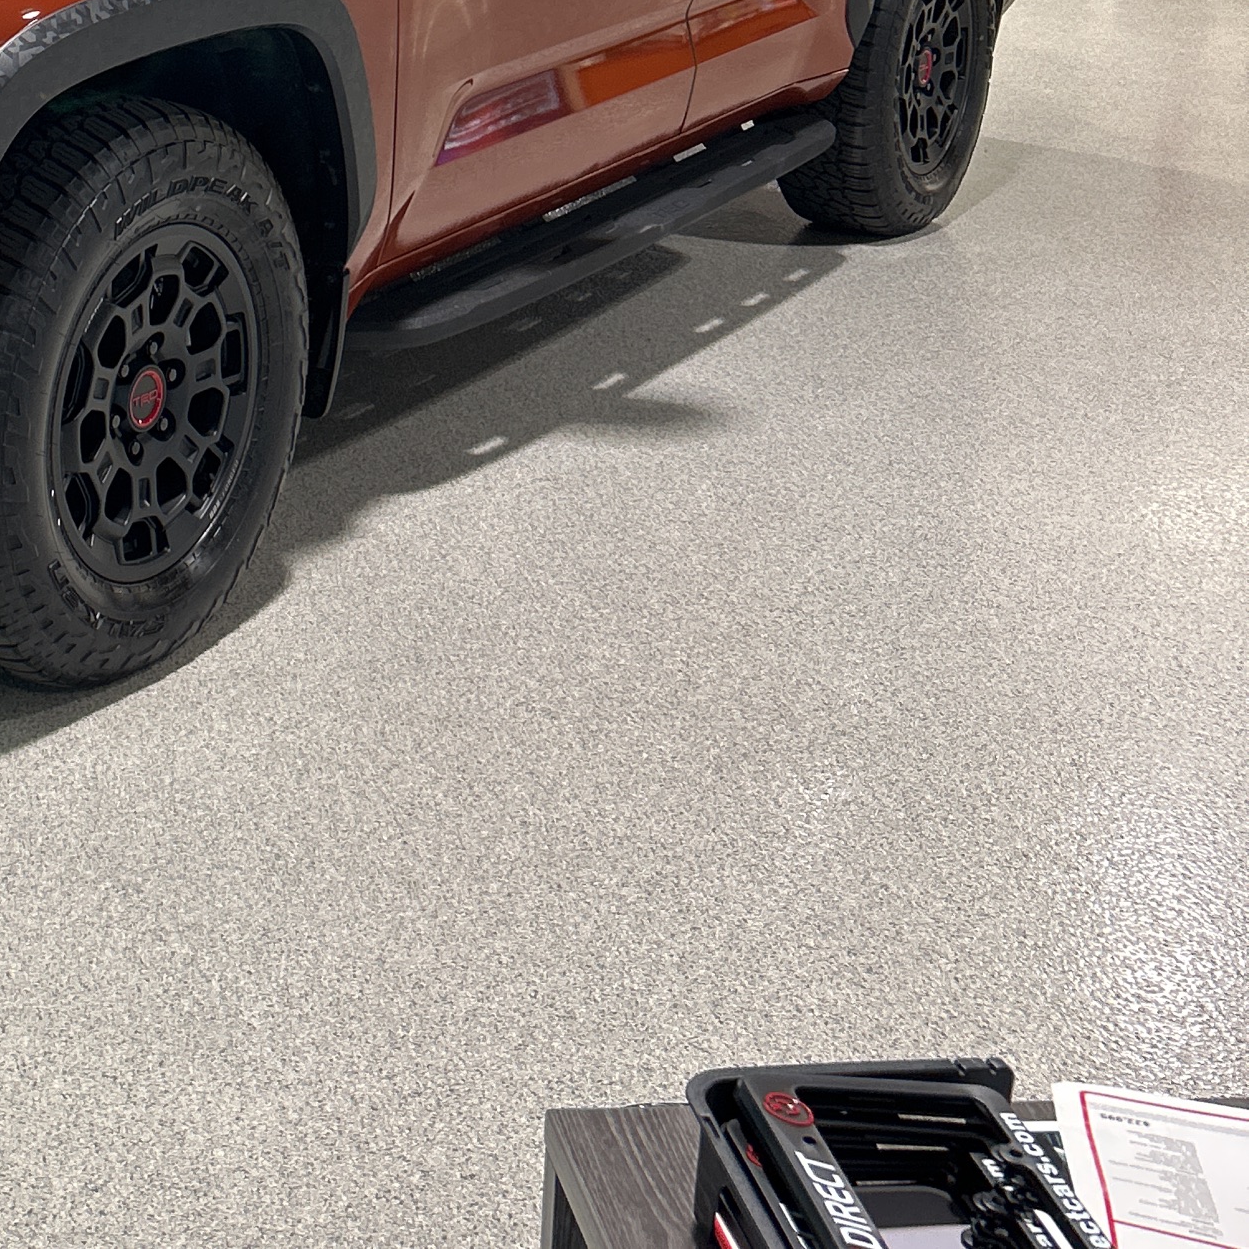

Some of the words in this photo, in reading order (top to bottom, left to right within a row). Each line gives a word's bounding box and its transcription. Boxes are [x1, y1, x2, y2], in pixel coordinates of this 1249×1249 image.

[113, 174, 259, 241] WILDPEAK
[132, 389, 158, 408] TRD
[794, 1151, 883, 1249] DIRECT
